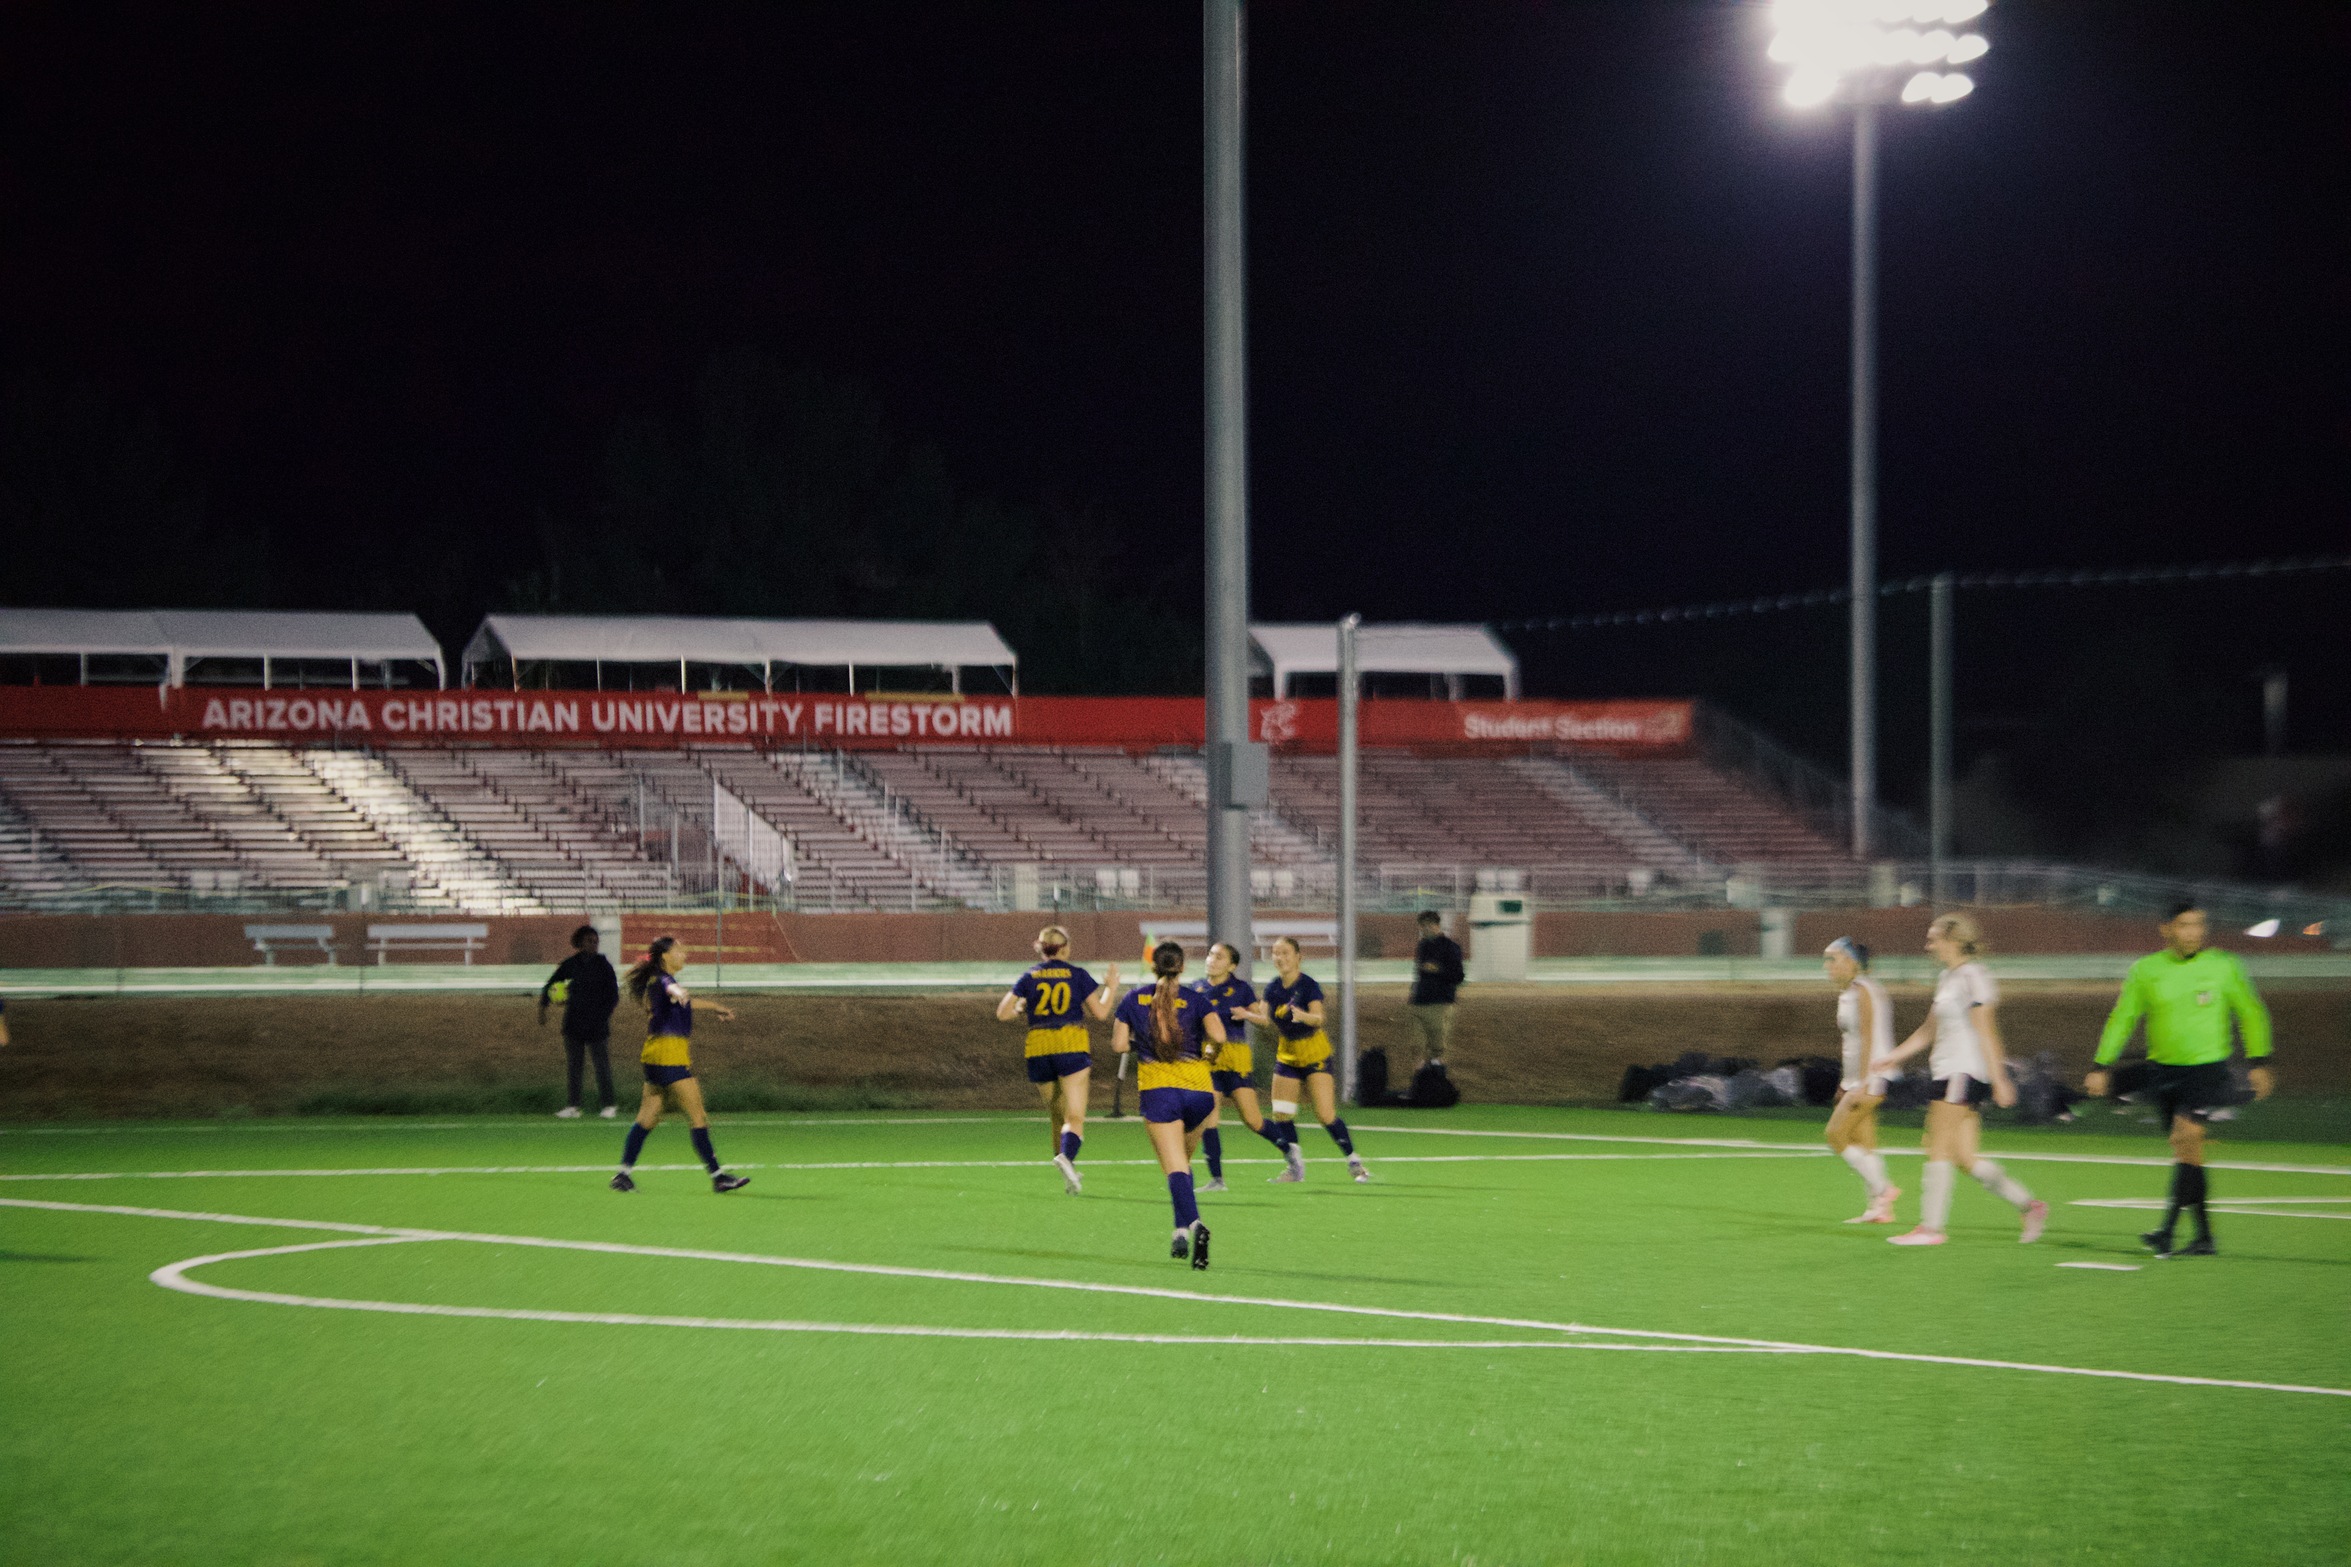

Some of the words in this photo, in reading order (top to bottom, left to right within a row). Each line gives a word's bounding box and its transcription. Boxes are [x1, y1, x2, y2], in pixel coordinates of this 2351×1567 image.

[202, 699, 372, 730] ARIZONA
[381, 700, 580, 732] CHRISTIAN
[591, 700, 803, 734] UNIVERSITY
[814, 703, 1012, 736] FIRESTORM
[1464, 714, 1551, 738] Student
[1554, 716, 1638, 740] Section
[1034, 982, 1070, 1015] 20
